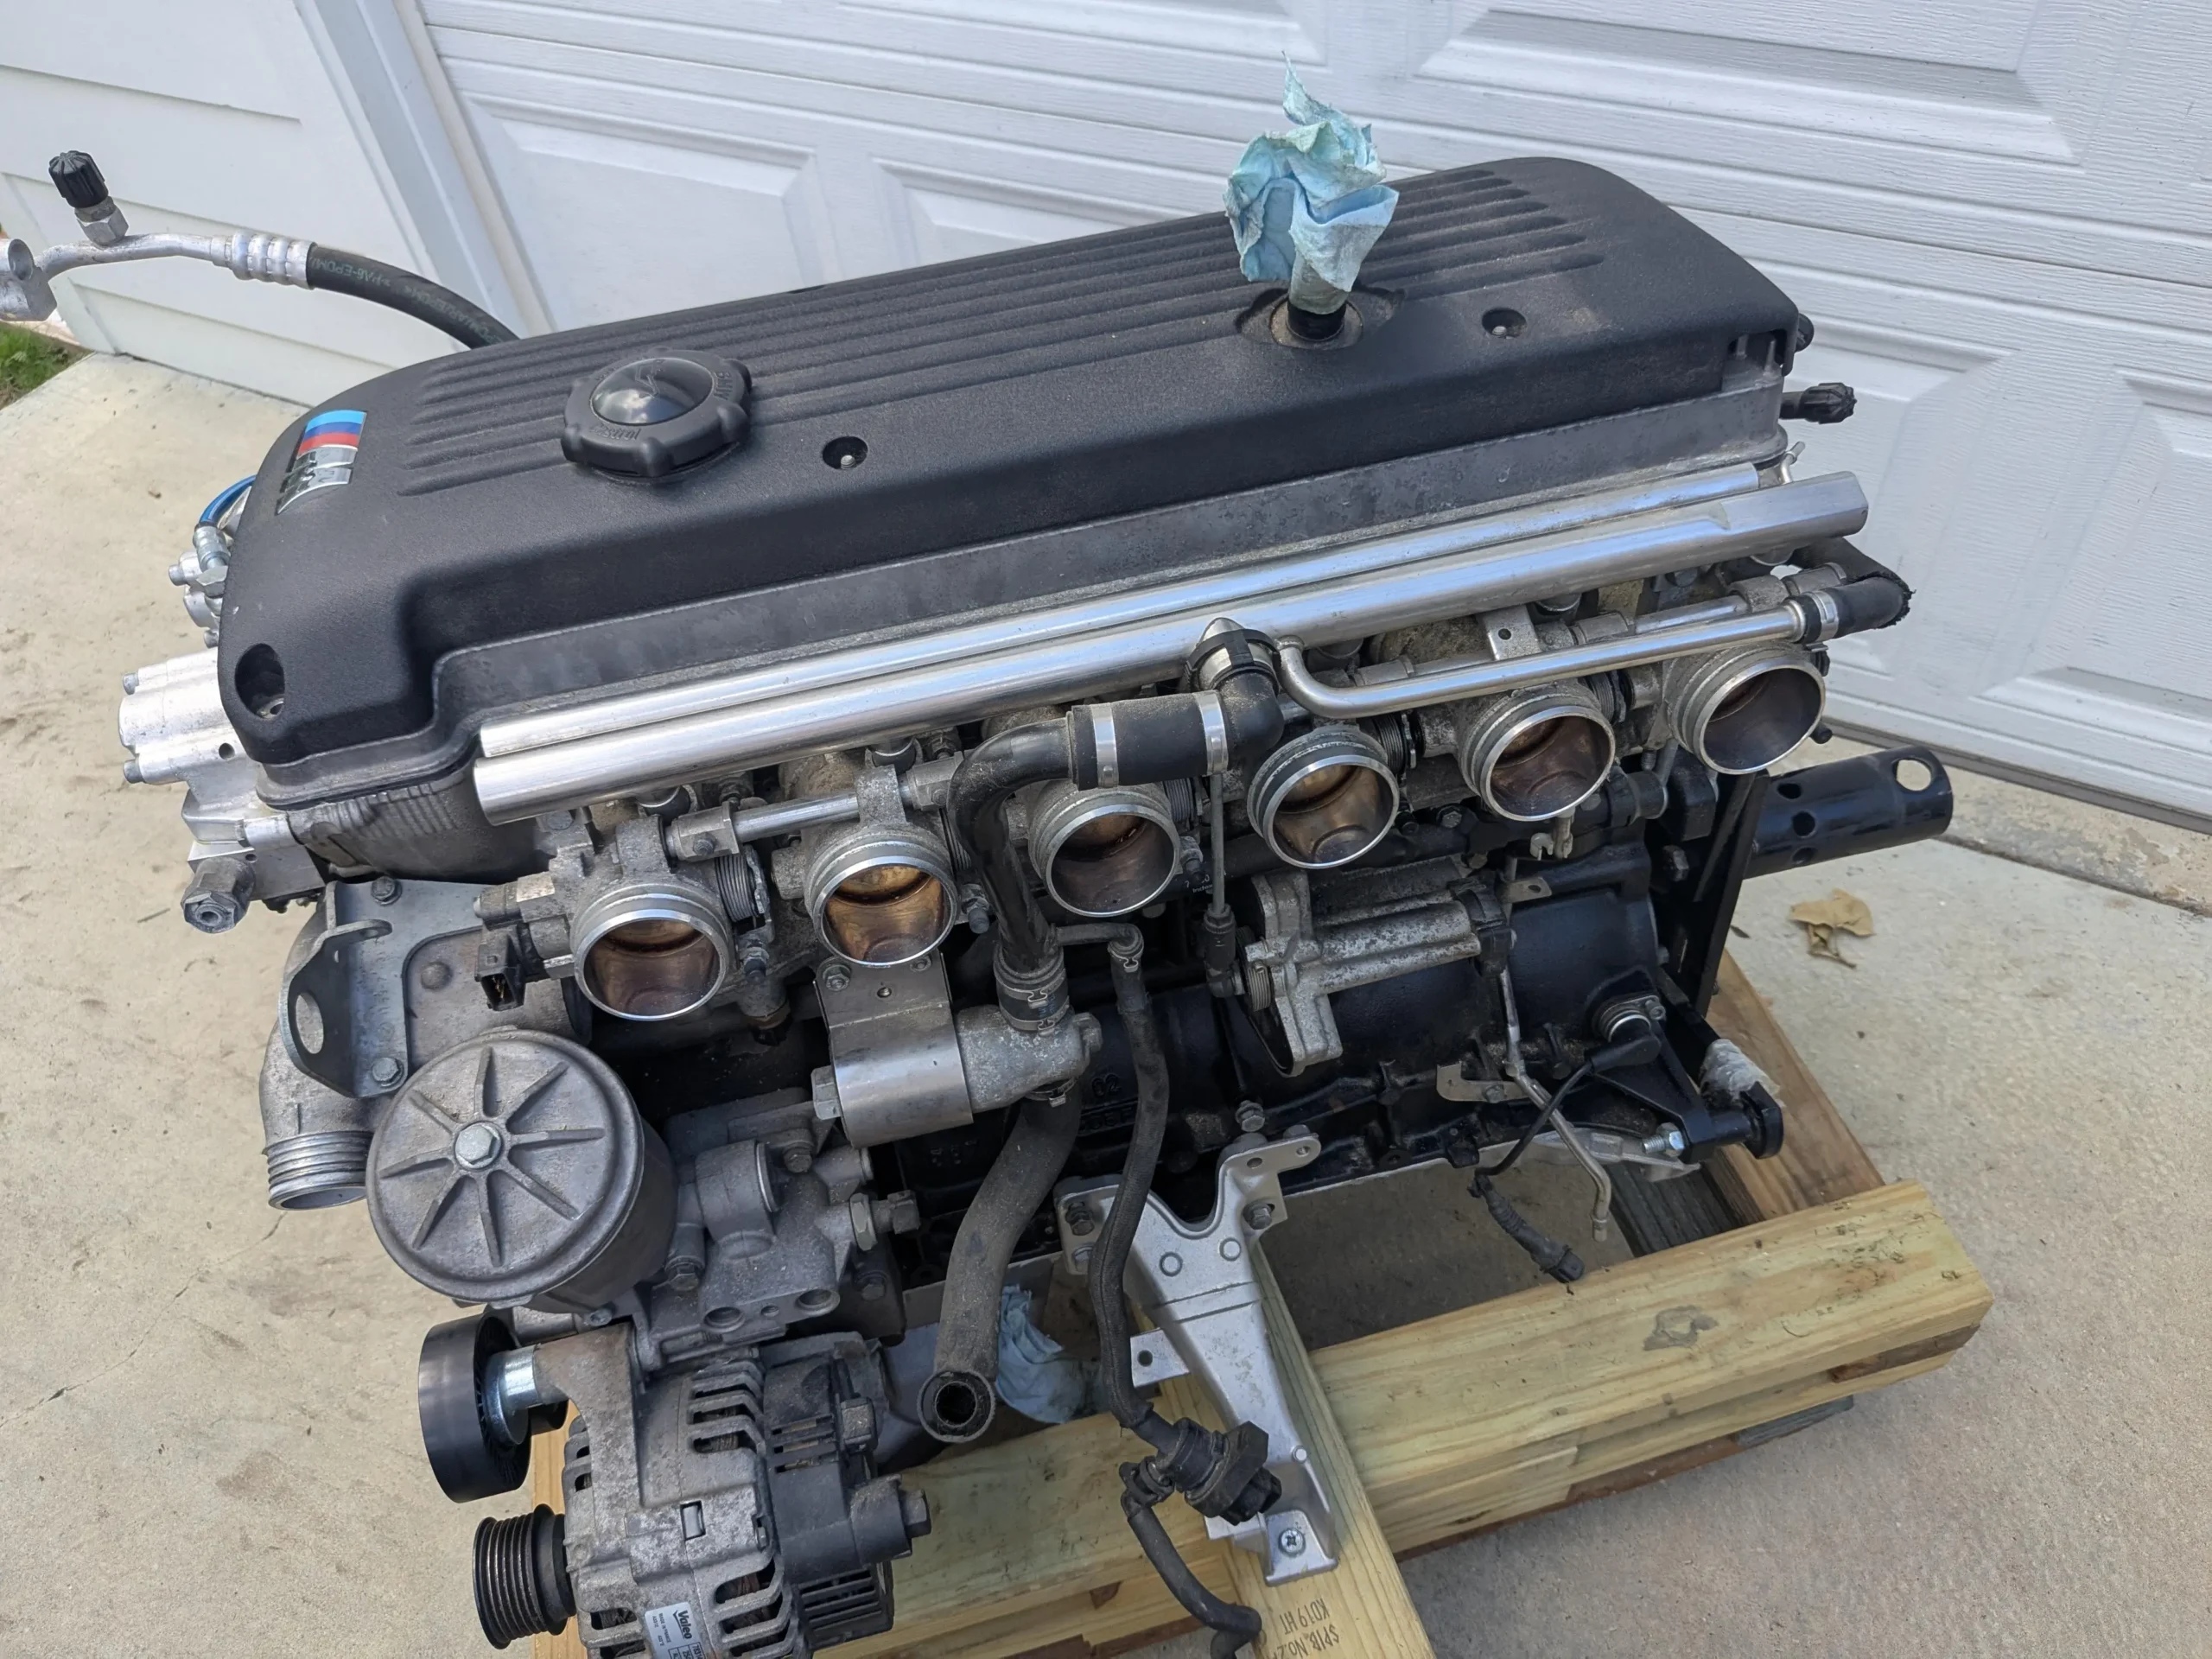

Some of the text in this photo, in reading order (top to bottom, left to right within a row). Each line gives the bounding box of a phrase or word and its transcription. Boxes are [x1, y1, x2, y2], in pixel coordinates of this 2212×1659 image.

[678, 1609, 693, 1640] Valeo
[1279, 1597, 1330, 1636] KD19 HT
